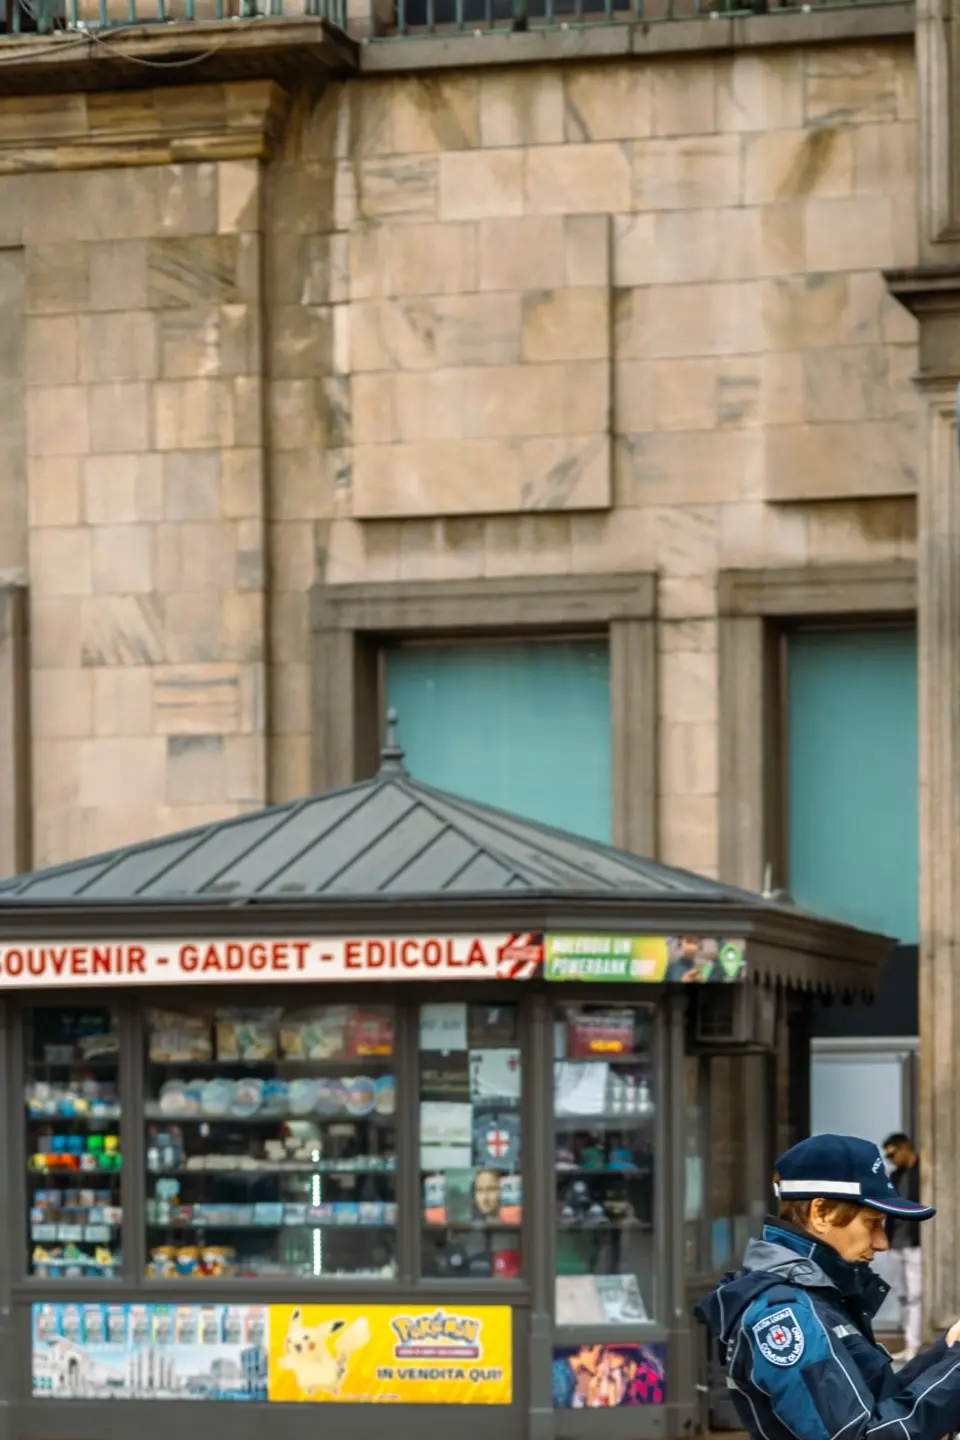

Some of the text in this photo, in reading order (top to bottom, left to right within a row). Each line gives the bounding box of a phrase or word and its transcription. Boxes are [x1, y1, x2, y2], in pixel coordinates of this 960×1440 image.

[0, 945, 146, 976] OUVENIR
[178, 942, 310, 972] GADGET
[344, 938, 488, 968] EDICOLA
[377, 1368, 393, 1379] IN
[397, 1367, 465, 1379] VENDITA
